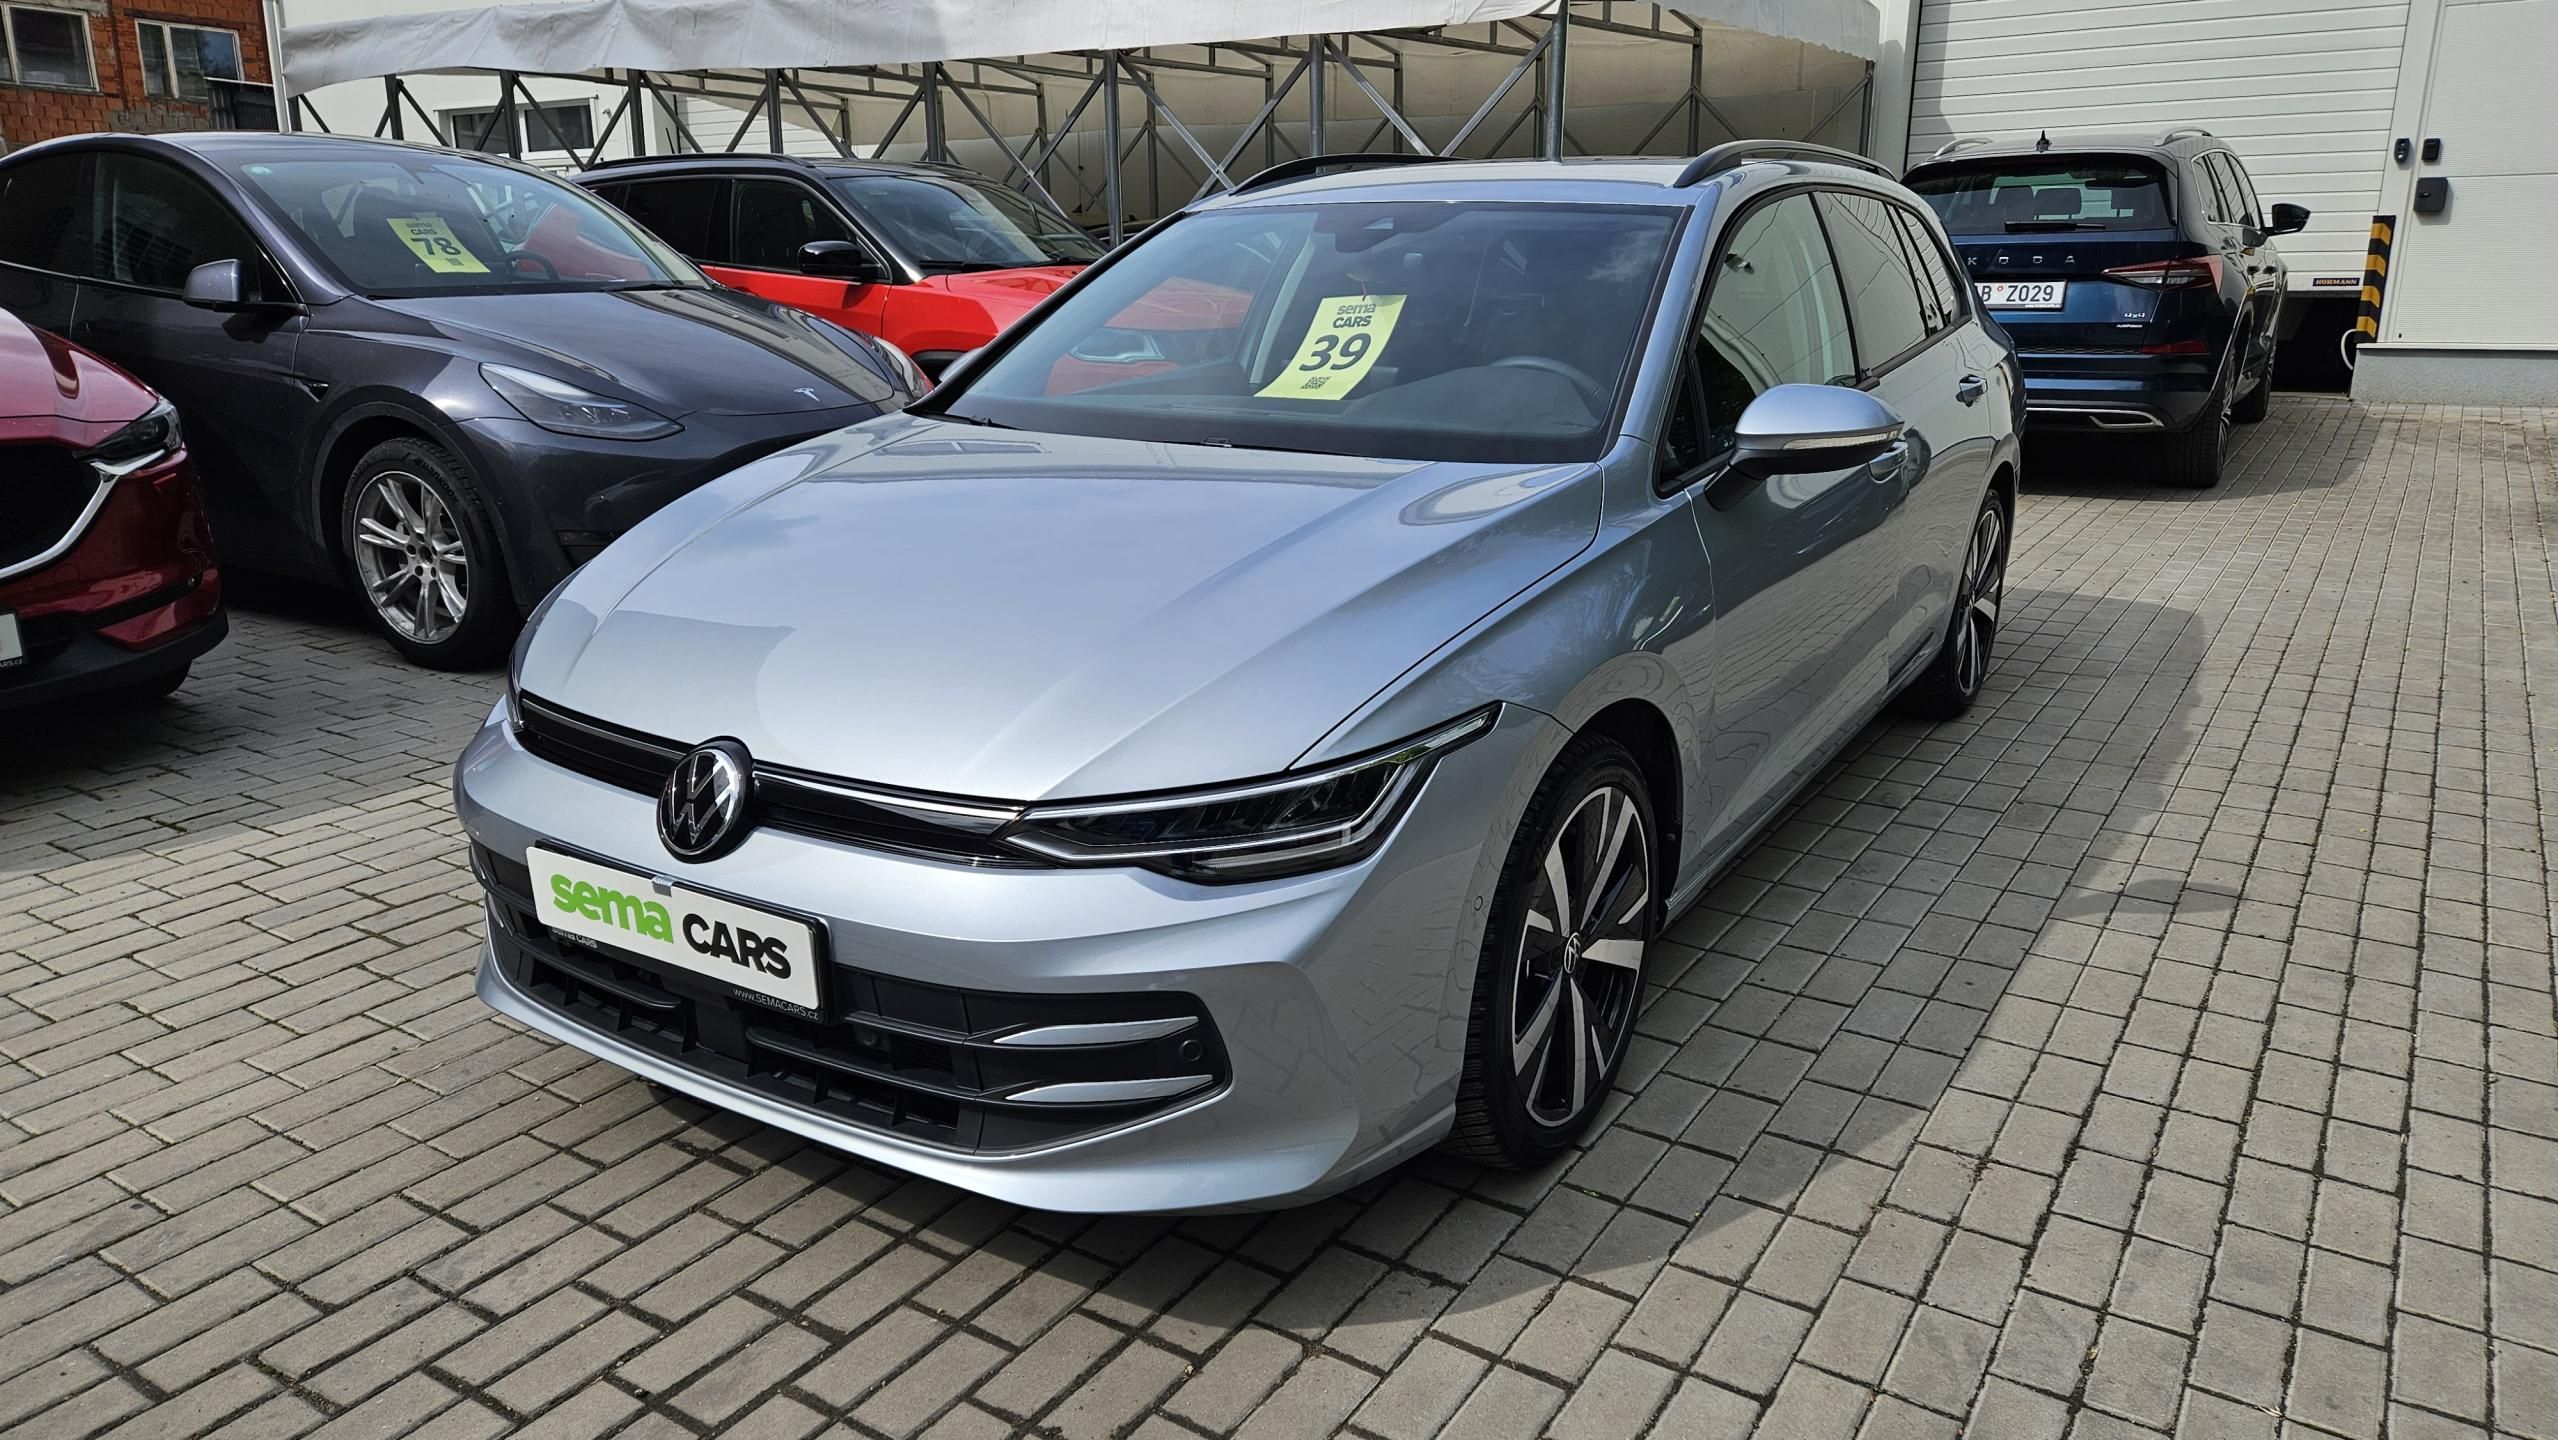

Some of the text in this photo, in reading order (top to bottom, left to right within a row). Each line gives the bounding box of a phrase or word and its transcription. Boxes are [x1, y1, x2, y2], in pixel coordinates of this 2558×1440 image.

[411, 238, 461, 255] 78
[1967, 255, 2075, 266] KODA
[1975, 285, 2054, 302] B Z029
[1337, 303, 1377, 315] sema
[1333, 315, 1372, 328] CARS
[1299, 333, 1372, 371] 39
[550, 873, 792, 980] sema CARS
[733, 988, 819, 1021] www.SEMACARS.cz
